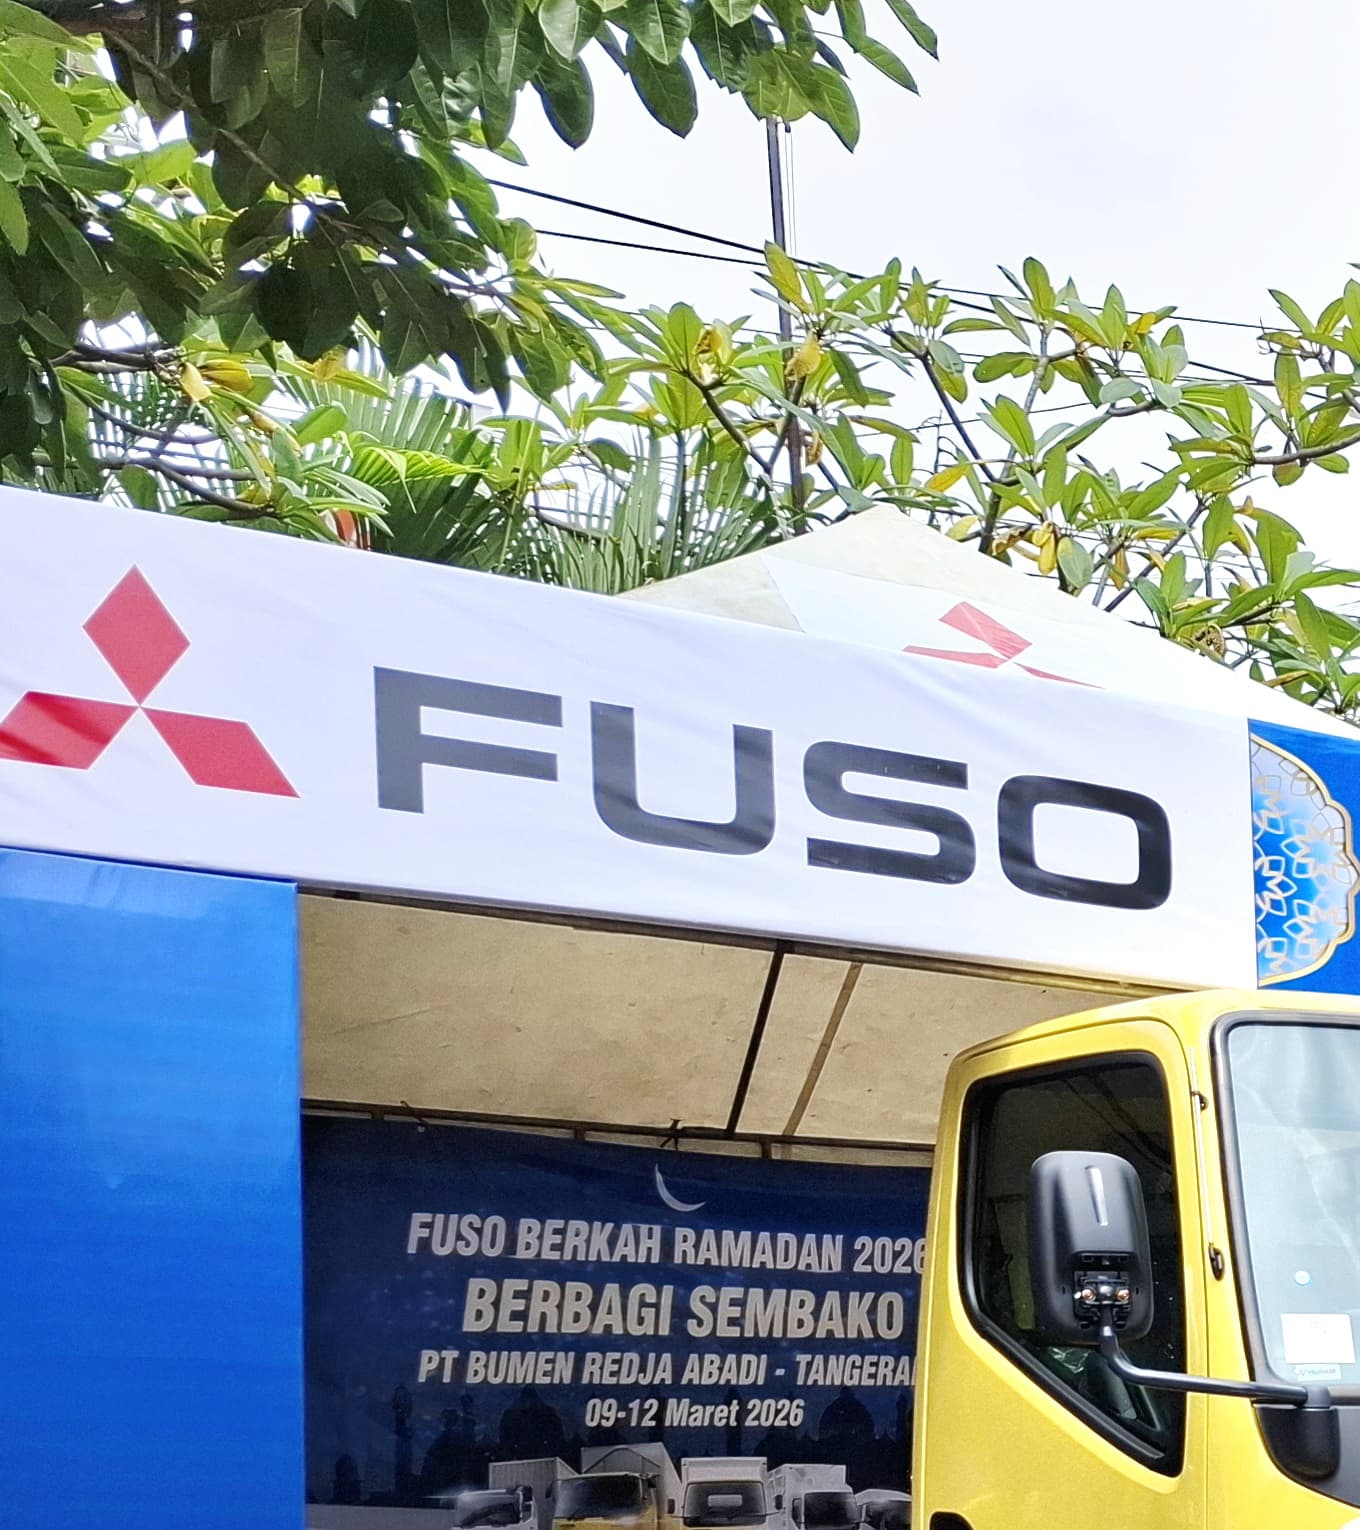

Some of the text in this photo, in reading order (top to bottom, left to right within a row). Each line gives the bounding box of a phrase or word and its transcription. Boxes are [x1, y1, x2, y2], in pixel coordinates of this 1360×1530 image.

[373, 665, 1172, 911] FUSO
[407, 1212, 927, 1274] FUSO BERKAH RAMADAN 2026
[463, 1278, 904, 1340] BERBAGI SEMBAKO
[418, 1350, 459, 1383] PT
[466, 1351, 573, 1384] BUMEN
[582, 1352, 672, 1385] REDJA
[681, 1352, 766, 1386] ABADI
[796, 1355, 918, 1386] TANGERA
[585, 1399, 804, 1427] 09-12 Maret 2026
